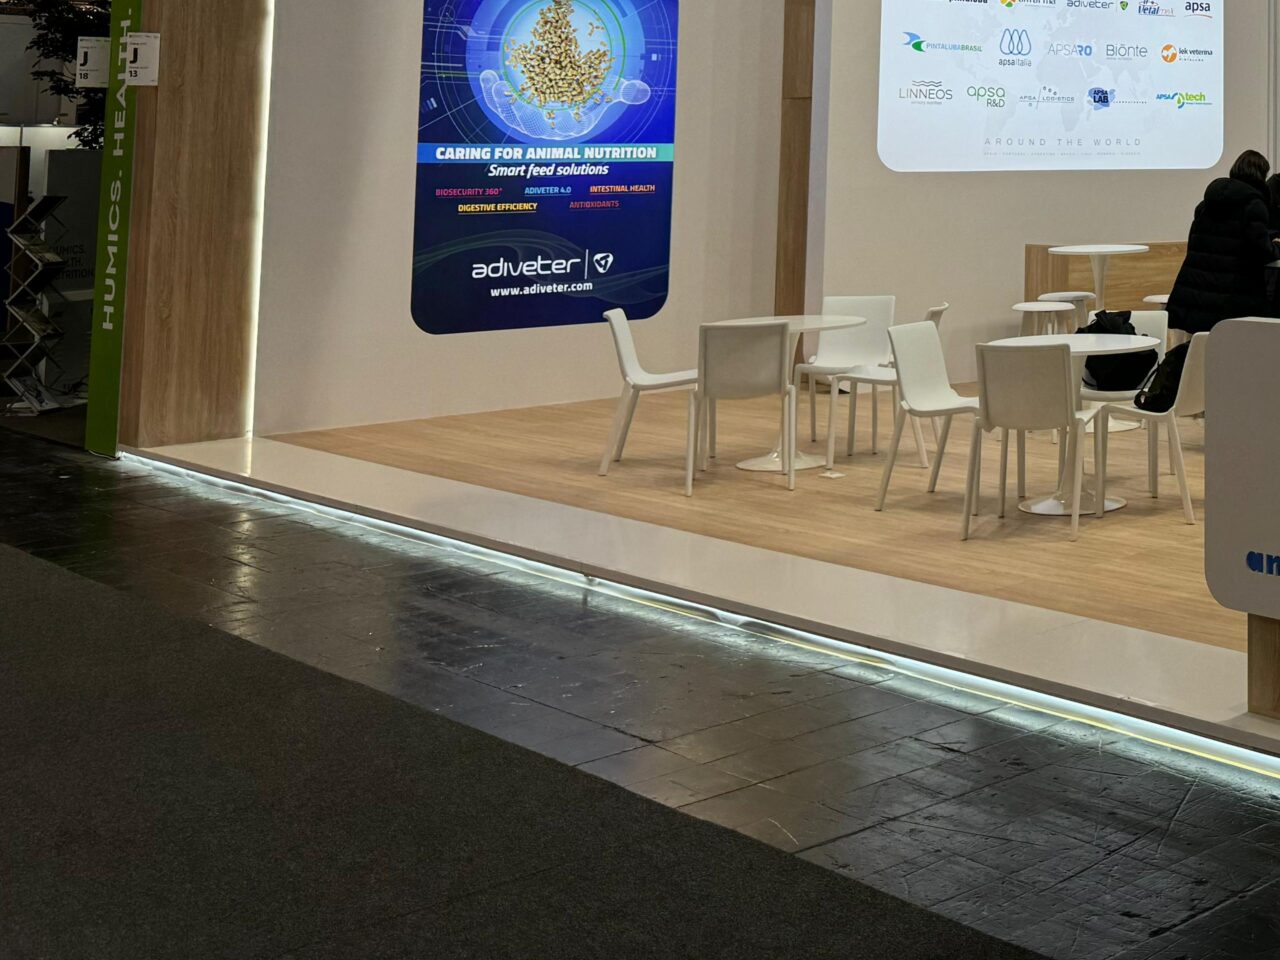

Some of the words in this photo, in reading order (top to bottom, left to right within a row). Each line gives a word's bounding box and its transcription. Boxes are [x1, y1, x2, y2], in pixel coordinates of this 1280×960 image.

[1185, 0, 1211, 13] apsa
[80, 50, 89, 67] J
[129, 47, 138, 64] J
[79, 72, 89, 80] 18
[129, 69, 138, 78] 13
[898, 87, 953, 100] LINNEOS
[966, 85, 1006, 102] apsa
[1093, 95, 1109, 103] LAB
[1185, 92, 1206, 101] tech
[986, 97, 1006, 108] R&D
[984, 137, 1046, 147] AROUND
[1056, 137, 1083, 147] THE
[1093, 137, 1142, 147] WORLD
[435, 147, 492, 160] CARING
[494, 147, 524, 160] FOR
[526, 147, 582, 159] ANIMAL
[584, 146, 657, 159] NUTRITION
[102, 171, 122, 330] HUMICS.
[112, 7, 132, 157] HEALTH.
[488, 163, 526, 177] Smart
[527, 163, 554, 179] feed
[556, 163, 609, 176] solutions
[435, 188, 483, 197] BIOSECURITY
[524, 186, 560, 195] ADIVETER
[590, 185, 628, 193] INTESTINAL
[630, 184, 656, 192] HEALTH
[457, 203, 496, 213] DIGESTIVE
[497, 202, 538, 212] EFFICIENCY
[569, 200, 620, 209] ANTIOXIDANTS
[471, 254, 581, 279] adiveter
[490, 281, 593, 297] www.adiveter.com
